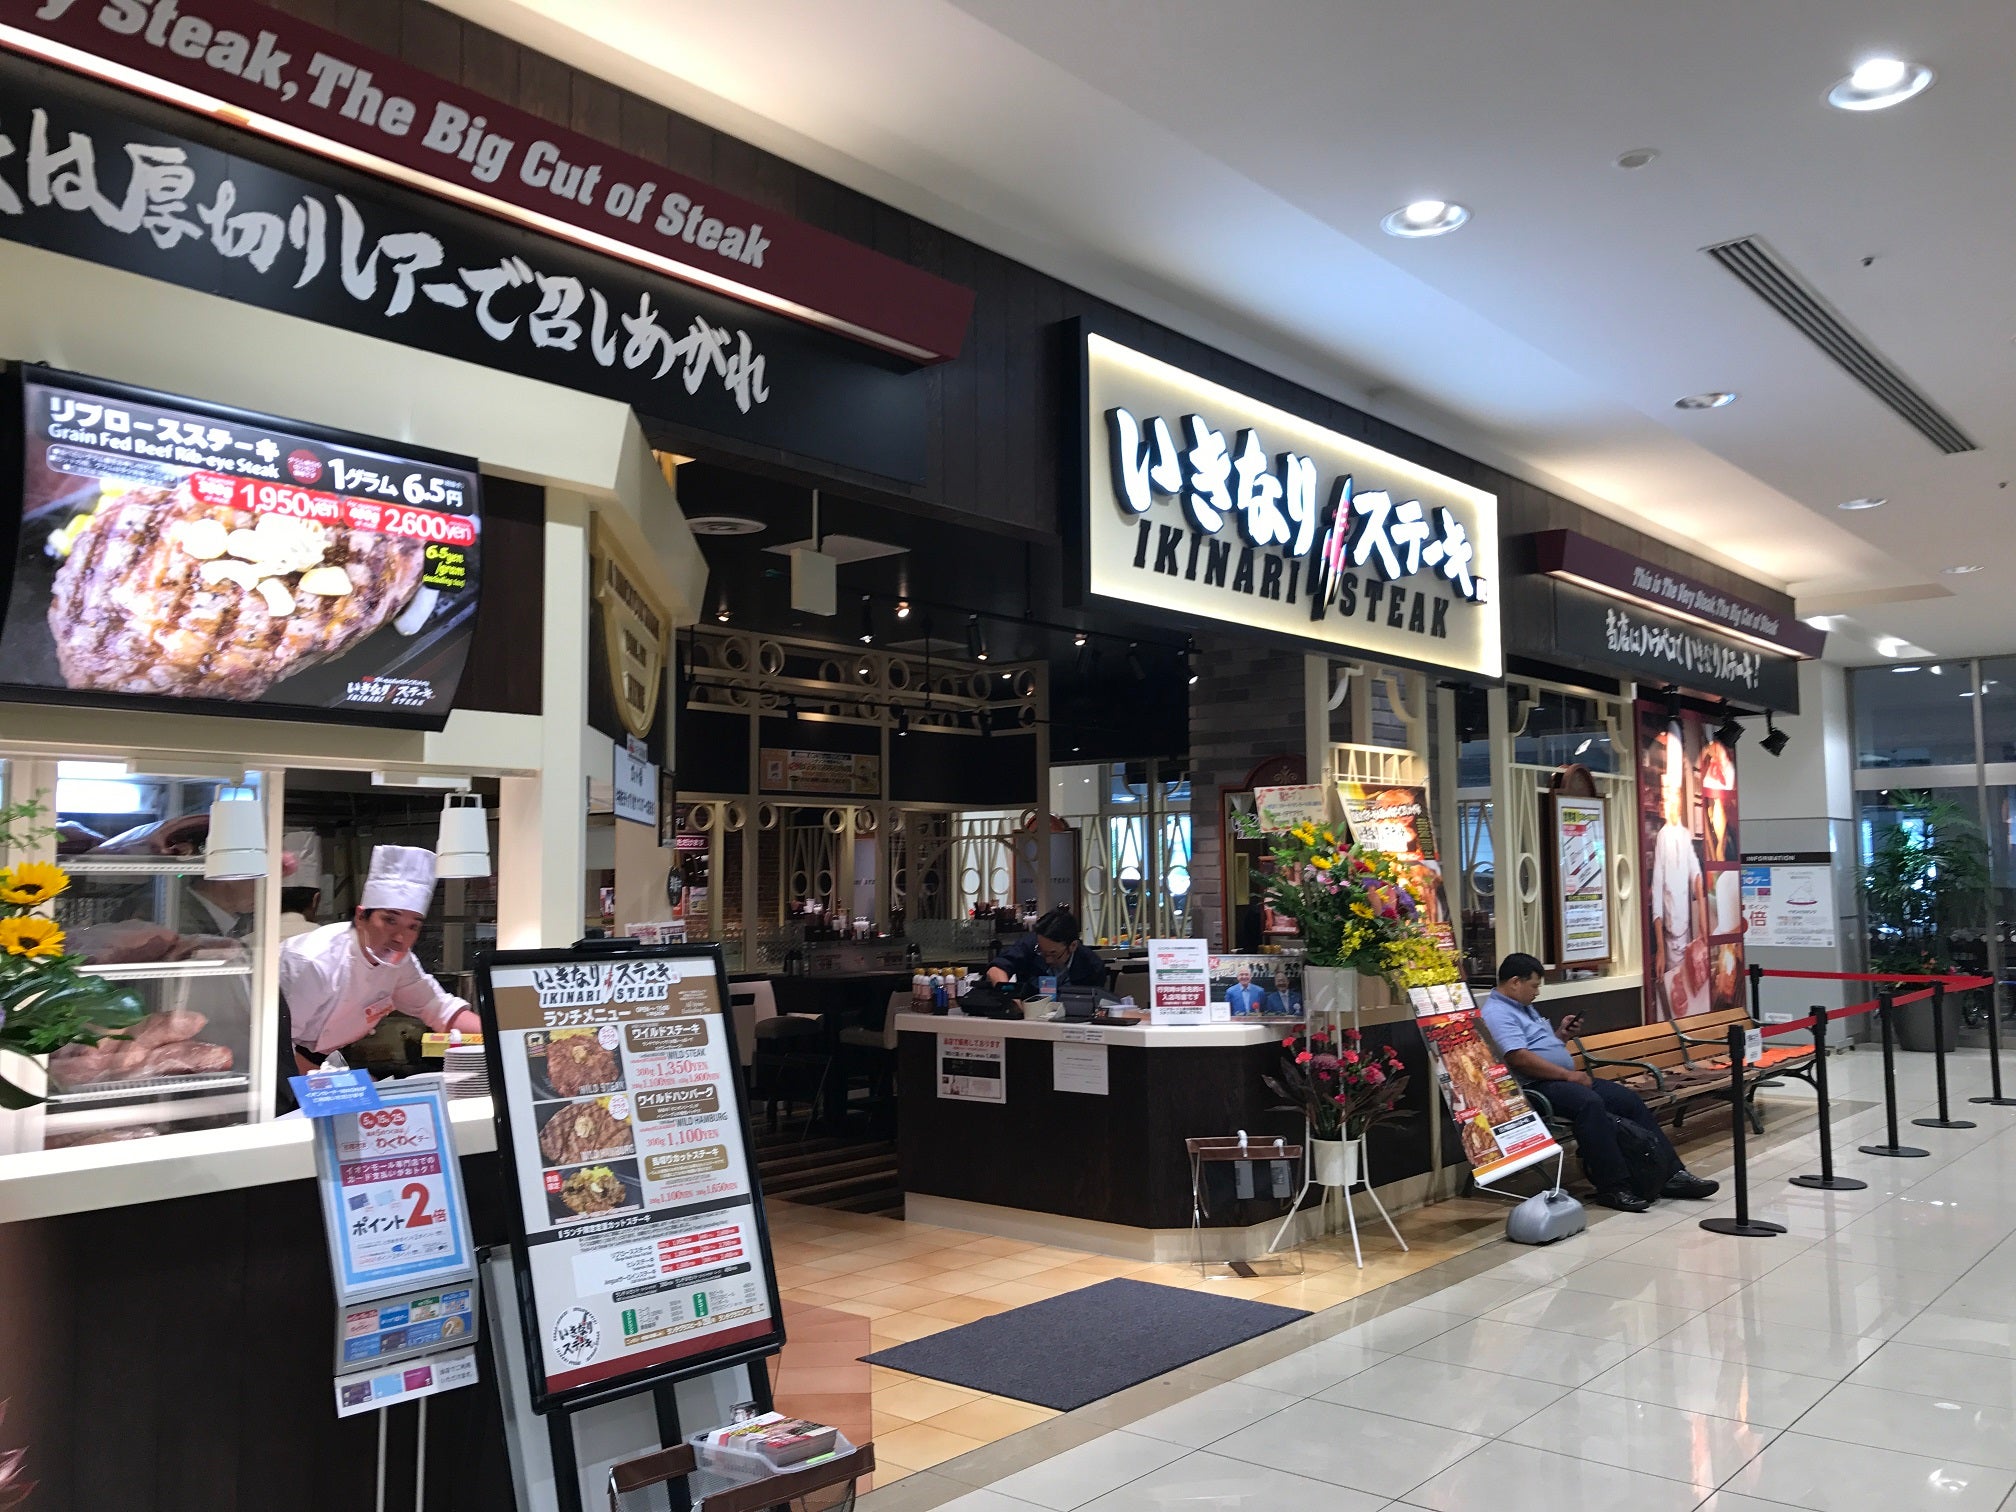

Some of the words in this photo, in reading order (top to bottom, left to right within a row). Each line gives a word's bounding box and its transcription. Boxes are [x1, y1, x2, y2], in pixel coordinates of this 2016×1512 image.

[98, 0, 299, 102] Steak,
[306, 52, 414, 136] The
[421, 101, 515, 183] Big
[520, 141, 602, 206] Cut
[604, 181, 656, 224] of
[662, 192, 772, 269] Steak
[0, 107, 768, 415] は厚切りレアーで召しあがれ
[48, 423, 98, 446] Grain
[99, 432, 133, 452] Fed
[134, 439, 174, 460] Beef
[235, 458, 281, 479] Steak
[50, 397, 281, 463] リブロースステーキ
[327, 458, 399, 497] 1グラム
[1106, 406, 1319, 558] いきなり
[1352, 490, 1474, 599] ステーキ
[1133, 519, 1300, 606] IKINARI
[1338, 571, 1450, 639] STEAK
[533, 964, 600, 990] いきなり
[615, 961, 672, 984] ステーキ
[542, 989, 601, 1005] IKINARI
[616, 985, 665, 1000] STEAK
[544, 1007, 632, 1027] ランチメニュー
[631, 1023, 701, 1040] ワイルドステーキ
[638, 1086, 714, 1106] ワイルドハンバーグ
